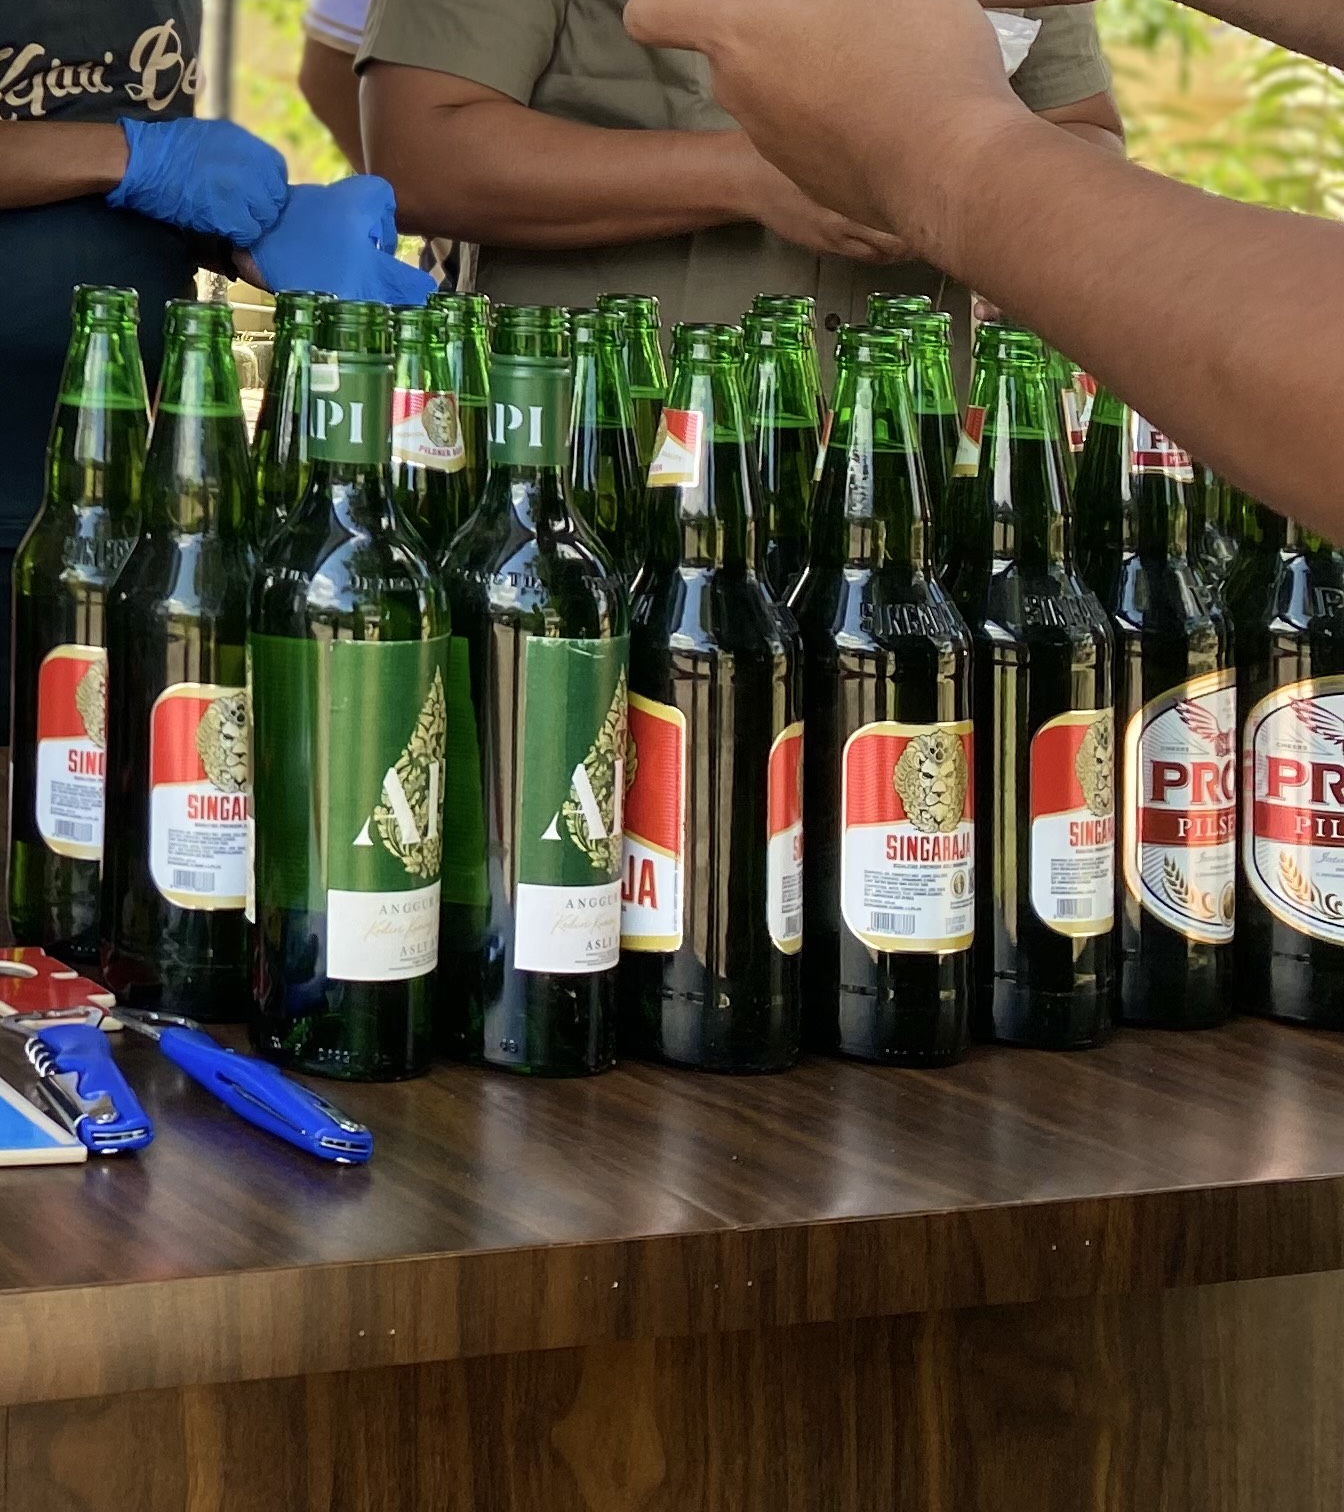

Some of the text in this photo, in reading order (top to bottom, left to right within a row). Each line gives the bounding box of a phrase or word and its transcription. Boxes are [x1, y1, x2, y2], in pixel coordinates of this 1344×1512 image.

[124, 18, 206, 111] Be
[310, 398, 364, 444] PI
[487, 402, 543, 447] PI
[187, 793, 248, 821] SINGA
[886, 832, 971, 862] SINGARAJA
